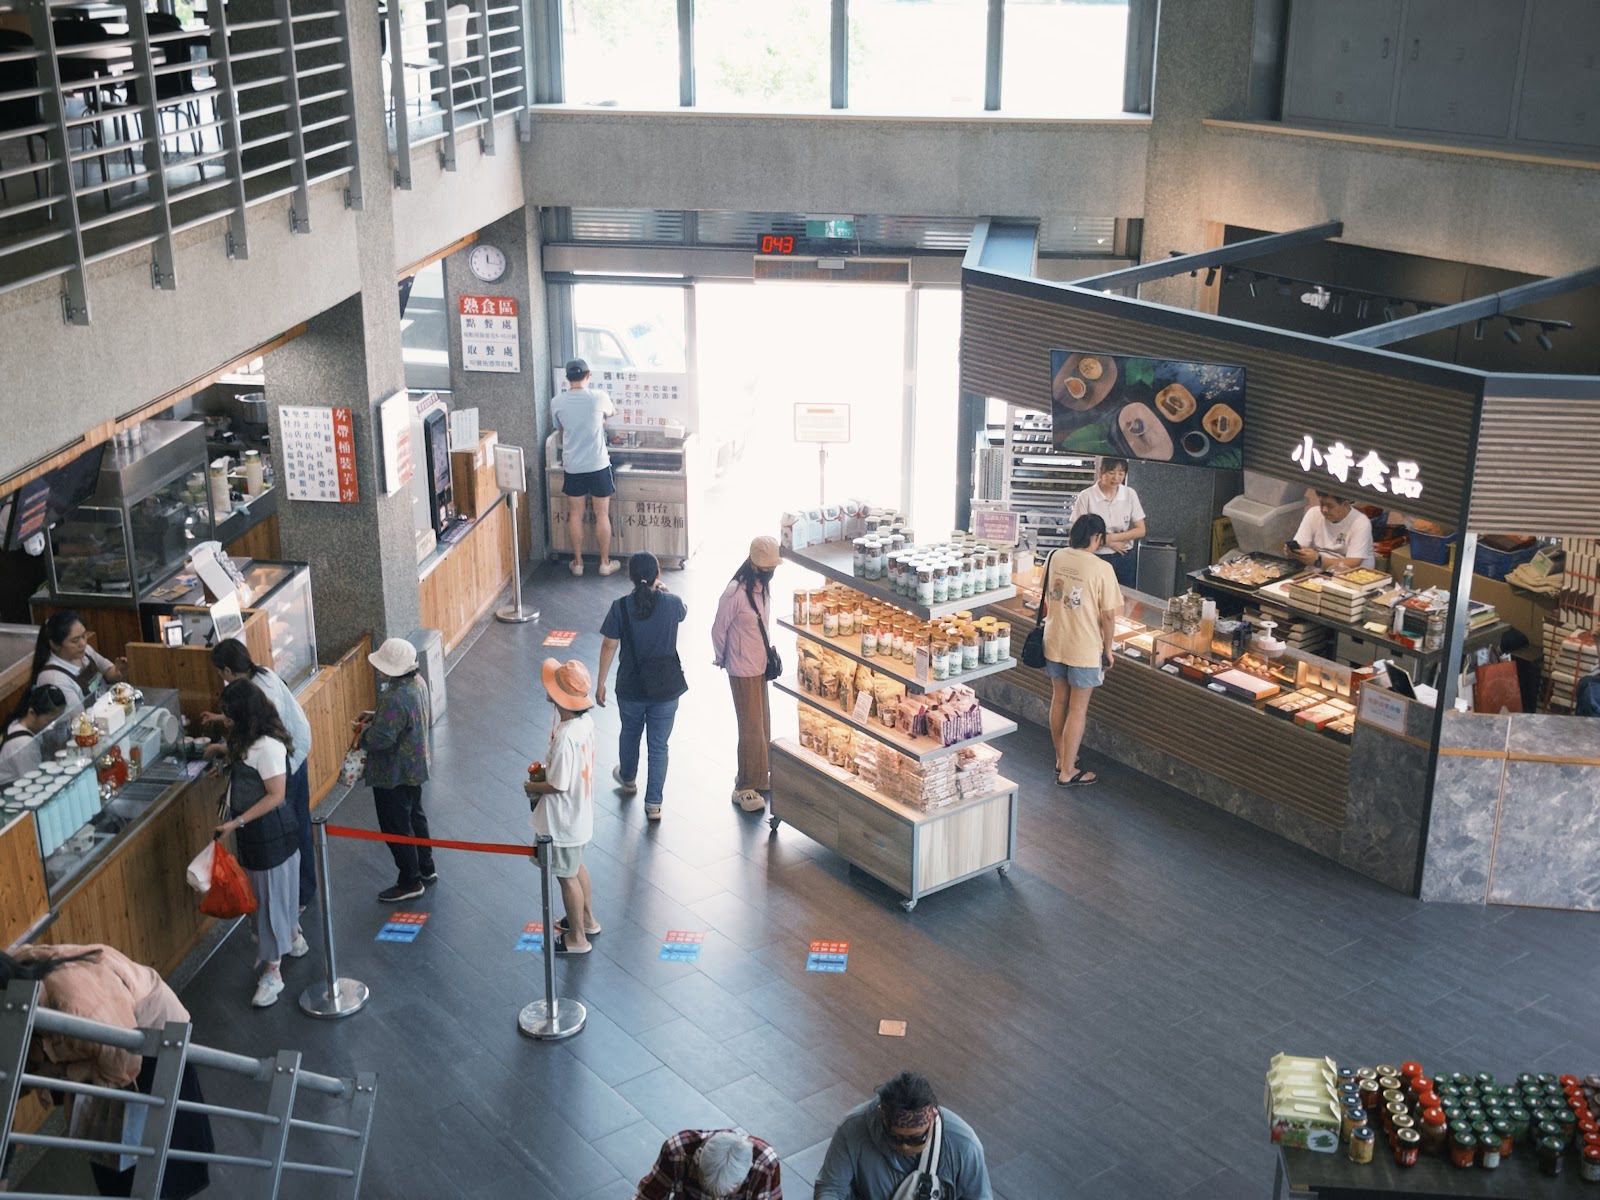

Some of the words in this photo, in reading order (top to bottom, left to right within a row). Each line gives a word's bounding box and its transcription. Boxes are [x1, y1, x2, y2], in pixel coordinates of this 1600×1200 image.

[762, 235, 794, 254] 043
[463, 297, 514, 315] 熟食區
[466, 318, 512, 330] 點餐處
[467, 345, 513, 357] 取餐處
[335, 408, 355, 502] 外帶桶裝芋冰
[636, 502, 668, 514] 醬料台
[625, 514, 684, 529] 不是垃圾桶
